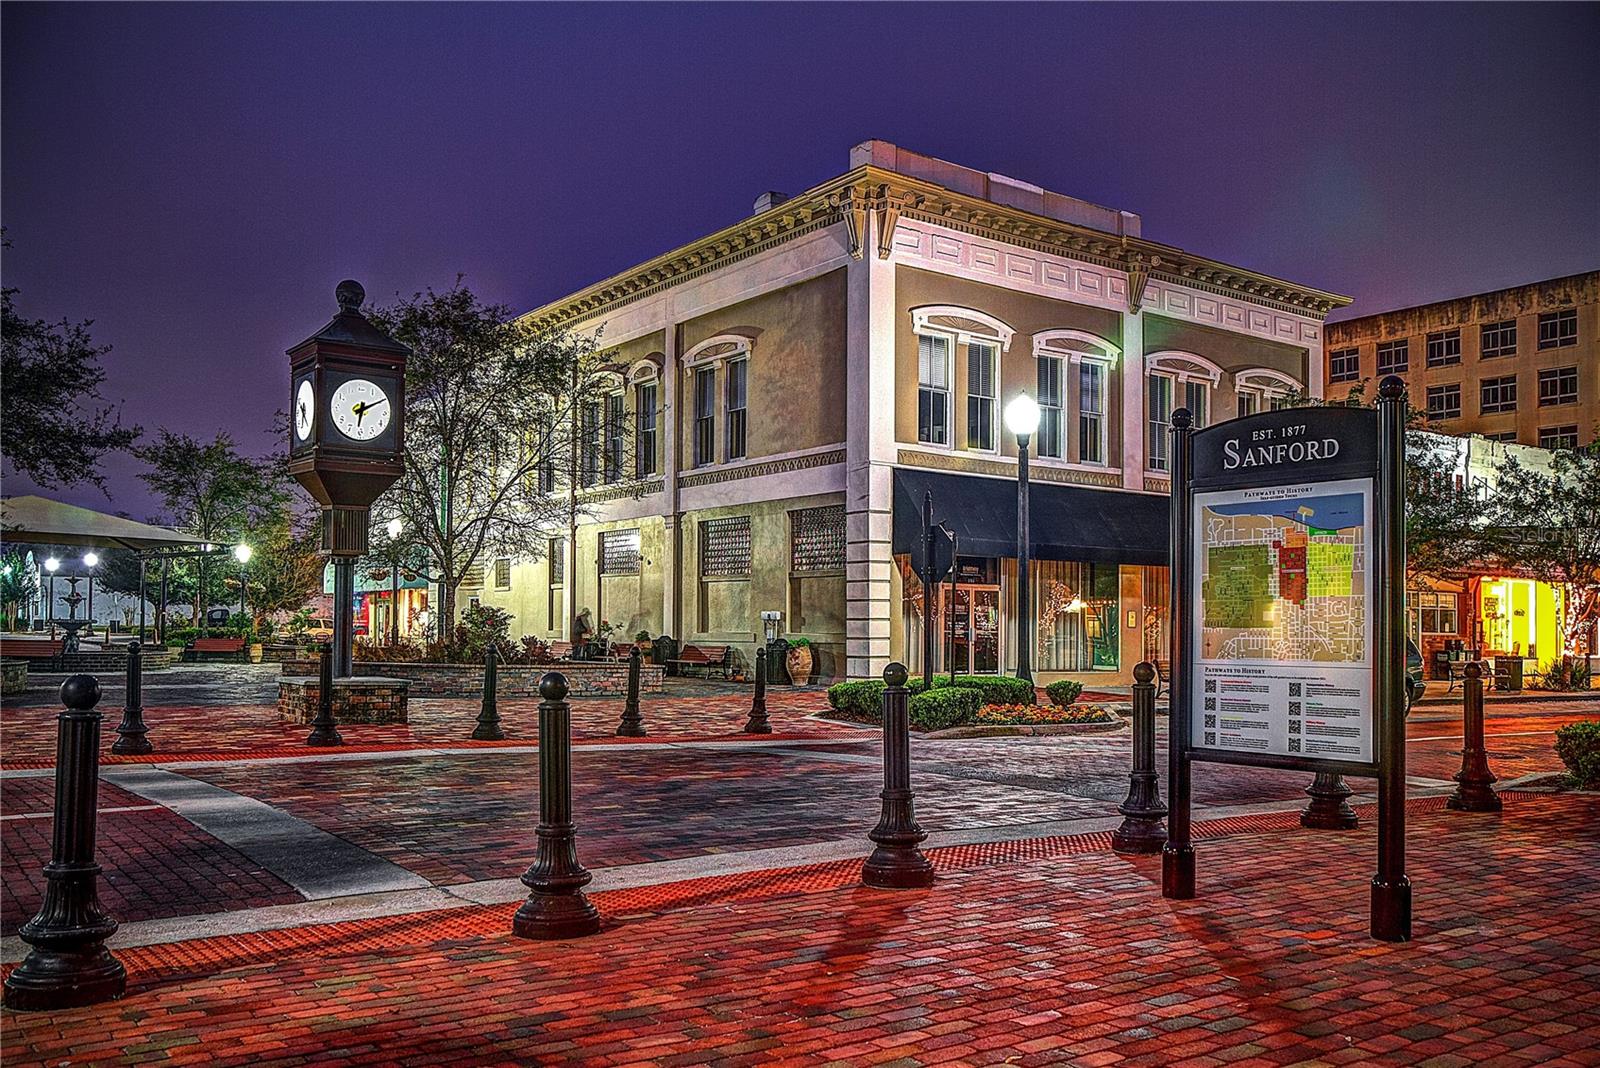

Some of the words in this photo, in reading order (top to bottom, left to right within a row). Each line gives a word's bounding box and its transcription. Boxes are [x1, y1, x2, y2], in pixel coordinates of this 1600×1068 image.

[1252, 429, 1277, 441] EST.
[1281, 425, 1306, 438] 1877
[1224, 439, 1339, 469] SANFORD
[1244, 490, 1276, 498] PATHWAYS
